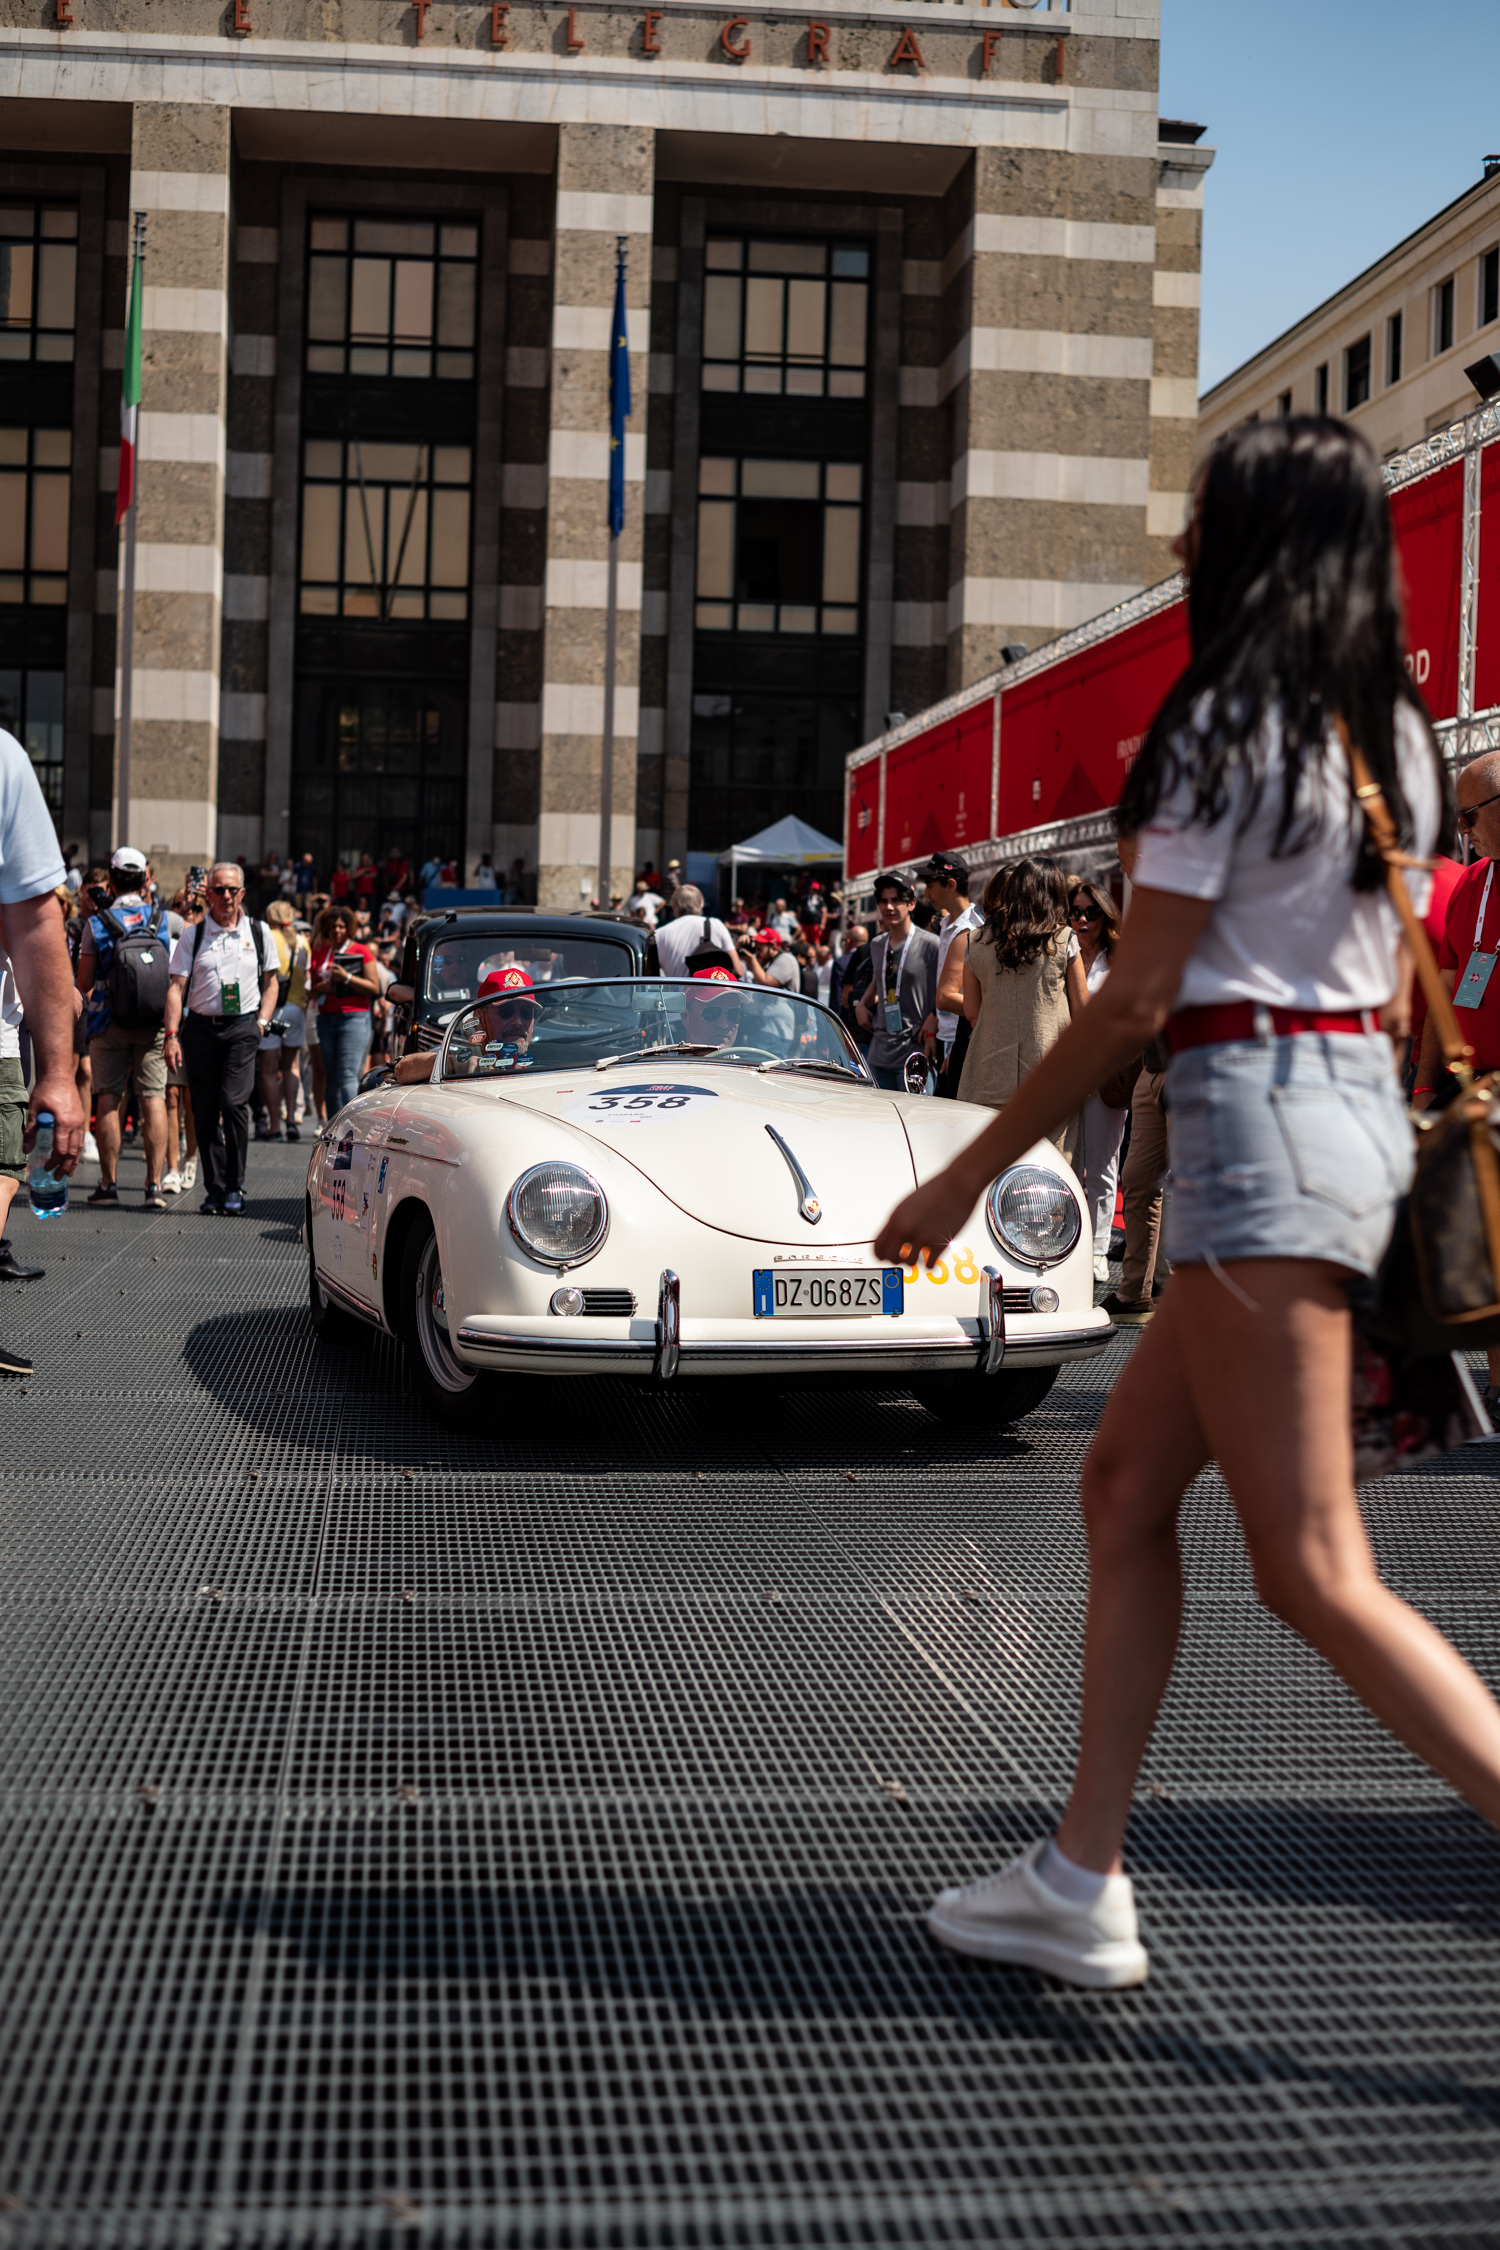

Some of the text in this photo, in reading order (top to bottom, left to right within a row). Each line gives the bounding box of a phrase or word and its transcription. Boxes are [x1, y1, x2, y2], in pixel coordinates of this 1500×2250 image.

[412, 0, 1064, 77] TELEGRAFI
[588, 1096, 692, 1110] 358
[331, 1179, 346, 1221] 358
